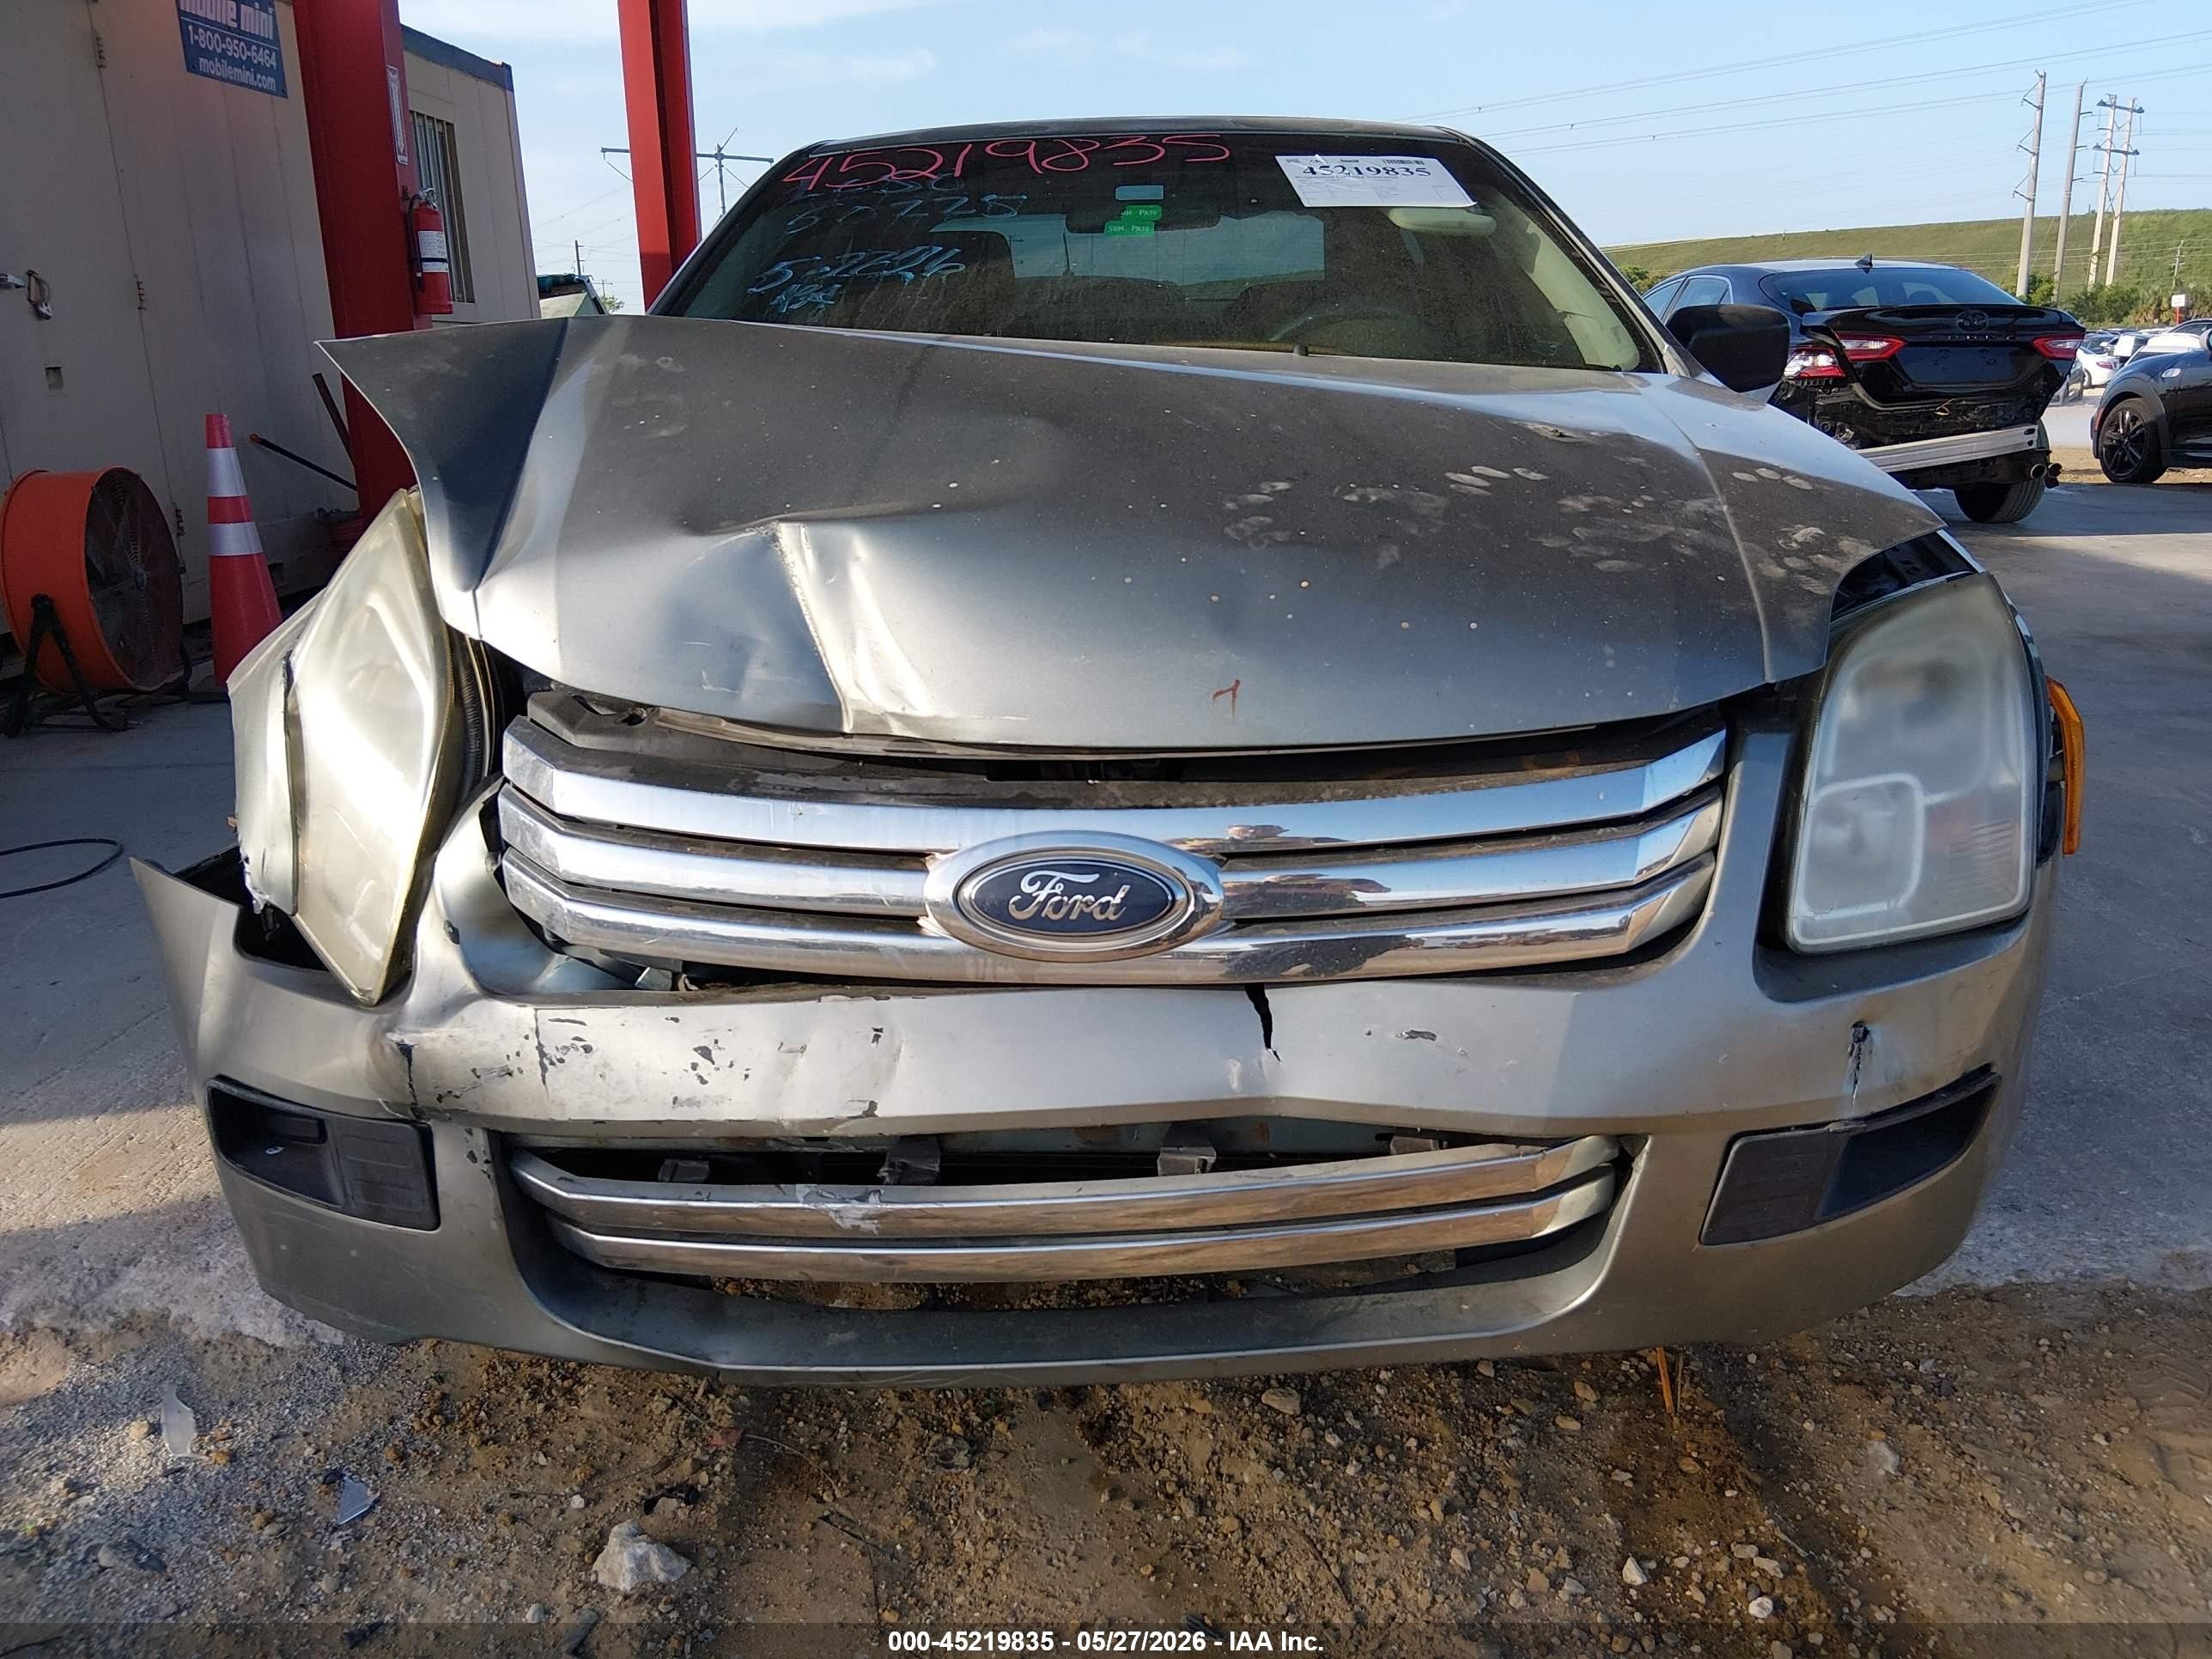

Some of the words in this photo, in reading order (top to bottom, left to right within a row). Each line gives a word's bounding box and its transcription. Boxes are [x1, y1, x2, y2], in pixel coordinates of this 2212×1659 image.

[240, 2, 274, 40] mini
[188, 24, 276, 69] 1-800-950-6464
[198, 57, 276, 91] mobilemini.com
[782, 134, 1231, 191] 45219835
[1303, 165, 1431, 177] 45219835
[1008, 870, 1131, 921] Ford
